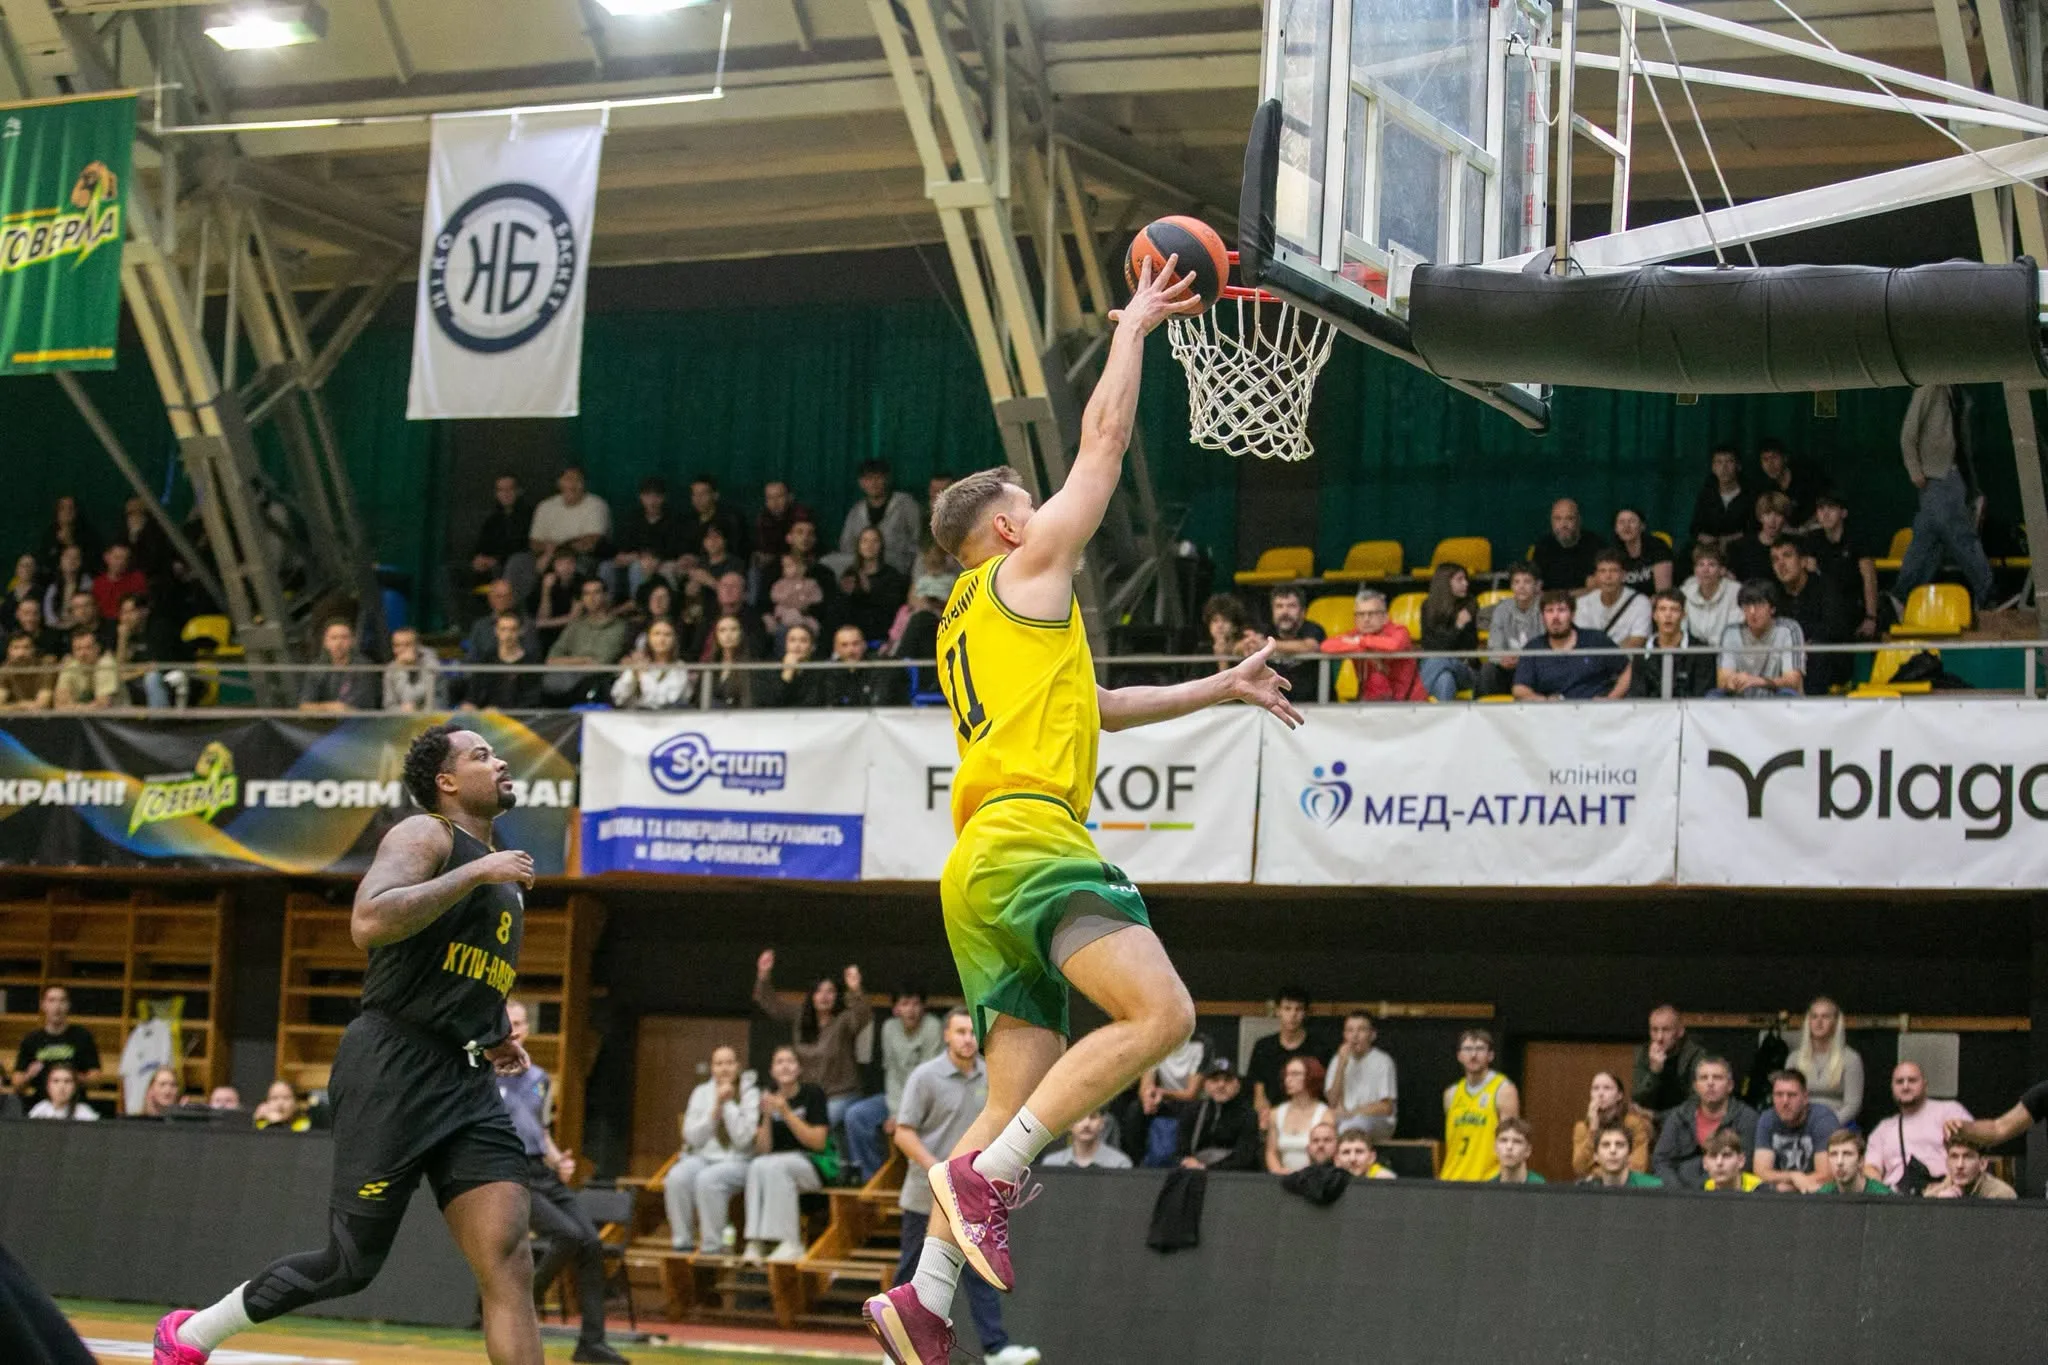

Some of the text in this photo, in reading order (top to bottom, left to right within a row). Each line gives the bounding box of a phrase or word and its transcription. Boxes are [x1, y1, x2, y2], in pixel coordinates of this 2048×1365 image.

[926, 765, 1196, 811] FKOF
[1549, 764, 1637, 786] клініка
[244, 779, 402, 808] ГЕРОЯМ
[1364, 795, 1636, 832] МЕД-АТЛАНТ
[496, 911, 512, 944] 8
